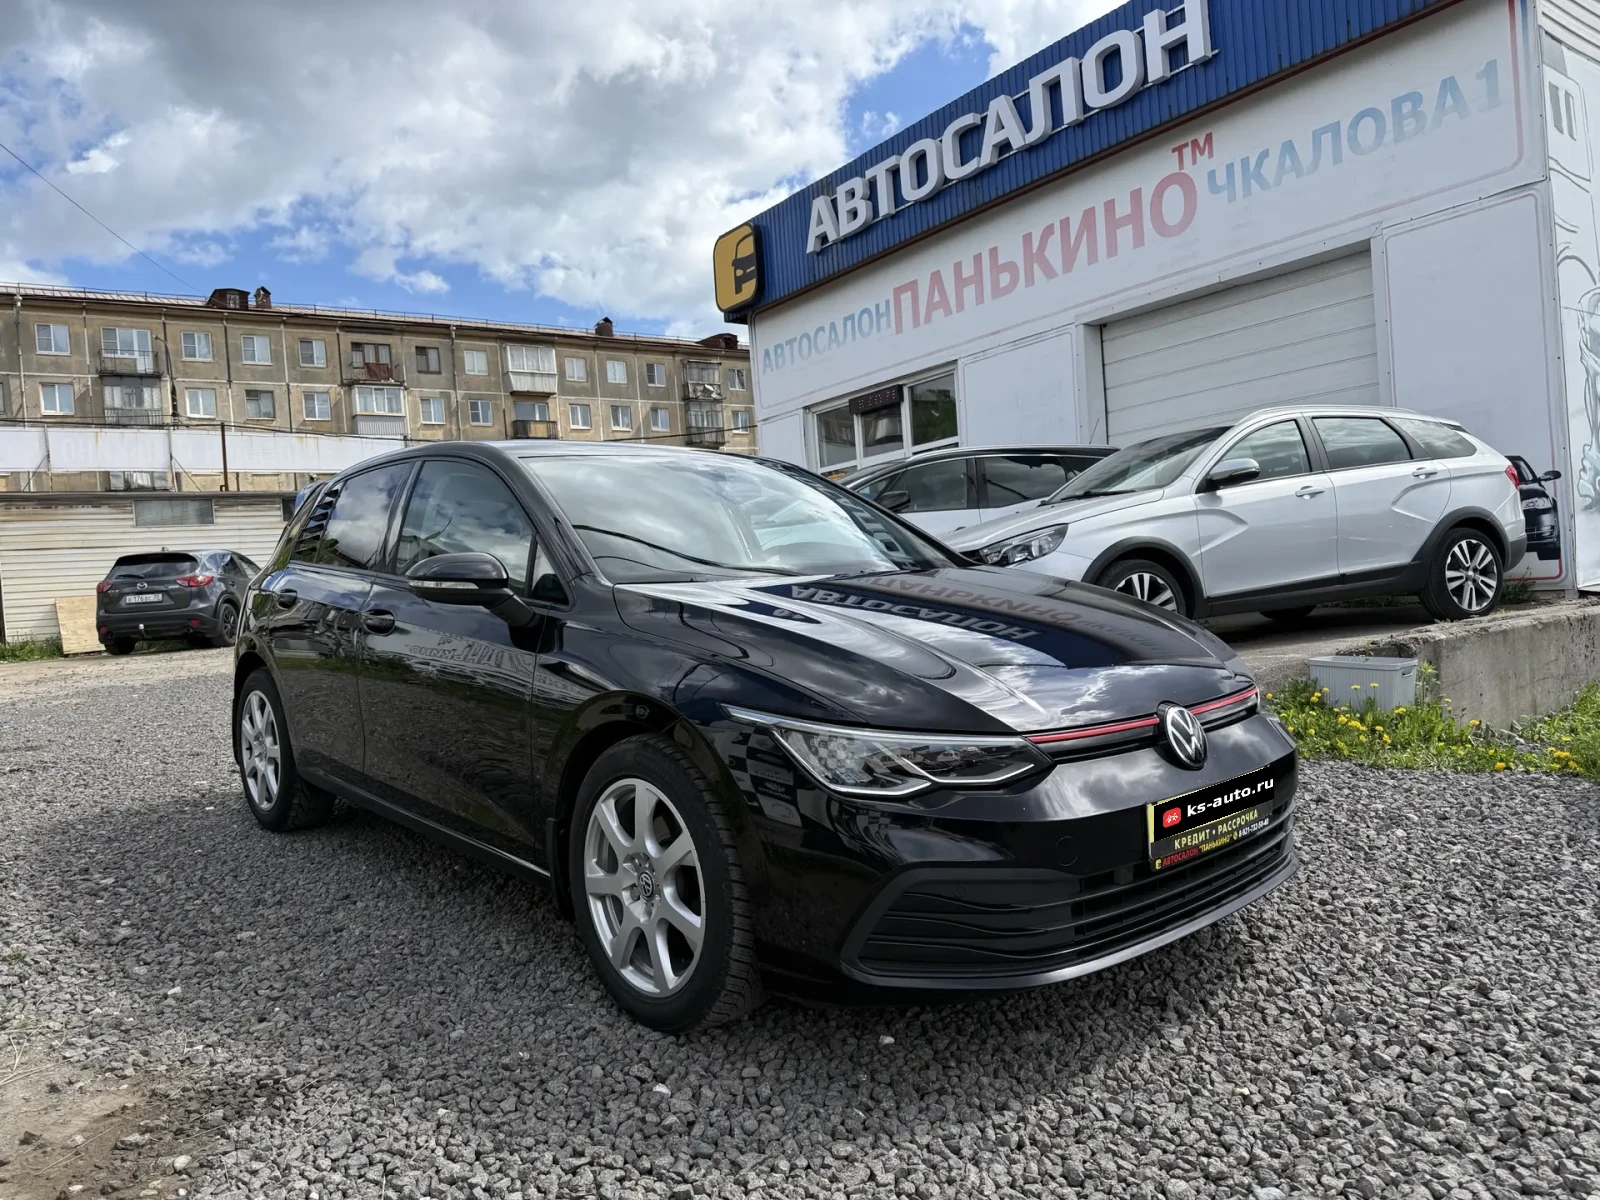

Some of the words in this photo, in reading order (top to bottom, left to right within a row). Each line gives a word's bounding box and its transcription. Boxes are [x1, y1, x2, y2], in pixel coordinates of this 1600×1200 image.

[806, 0, 1212, 254] АВТОСАЛОН
[762, 298, 891, 375] АВТОСАЛОН
[892, 172, 1198, 335] ПАНЬКИНО
[1162, 847, 1199, 867] АВТОСАЛОН
[1174, 829, 1211, 850] КРЕДИТ
[1217, 809, 1258, 835] РАССРОЧКА
